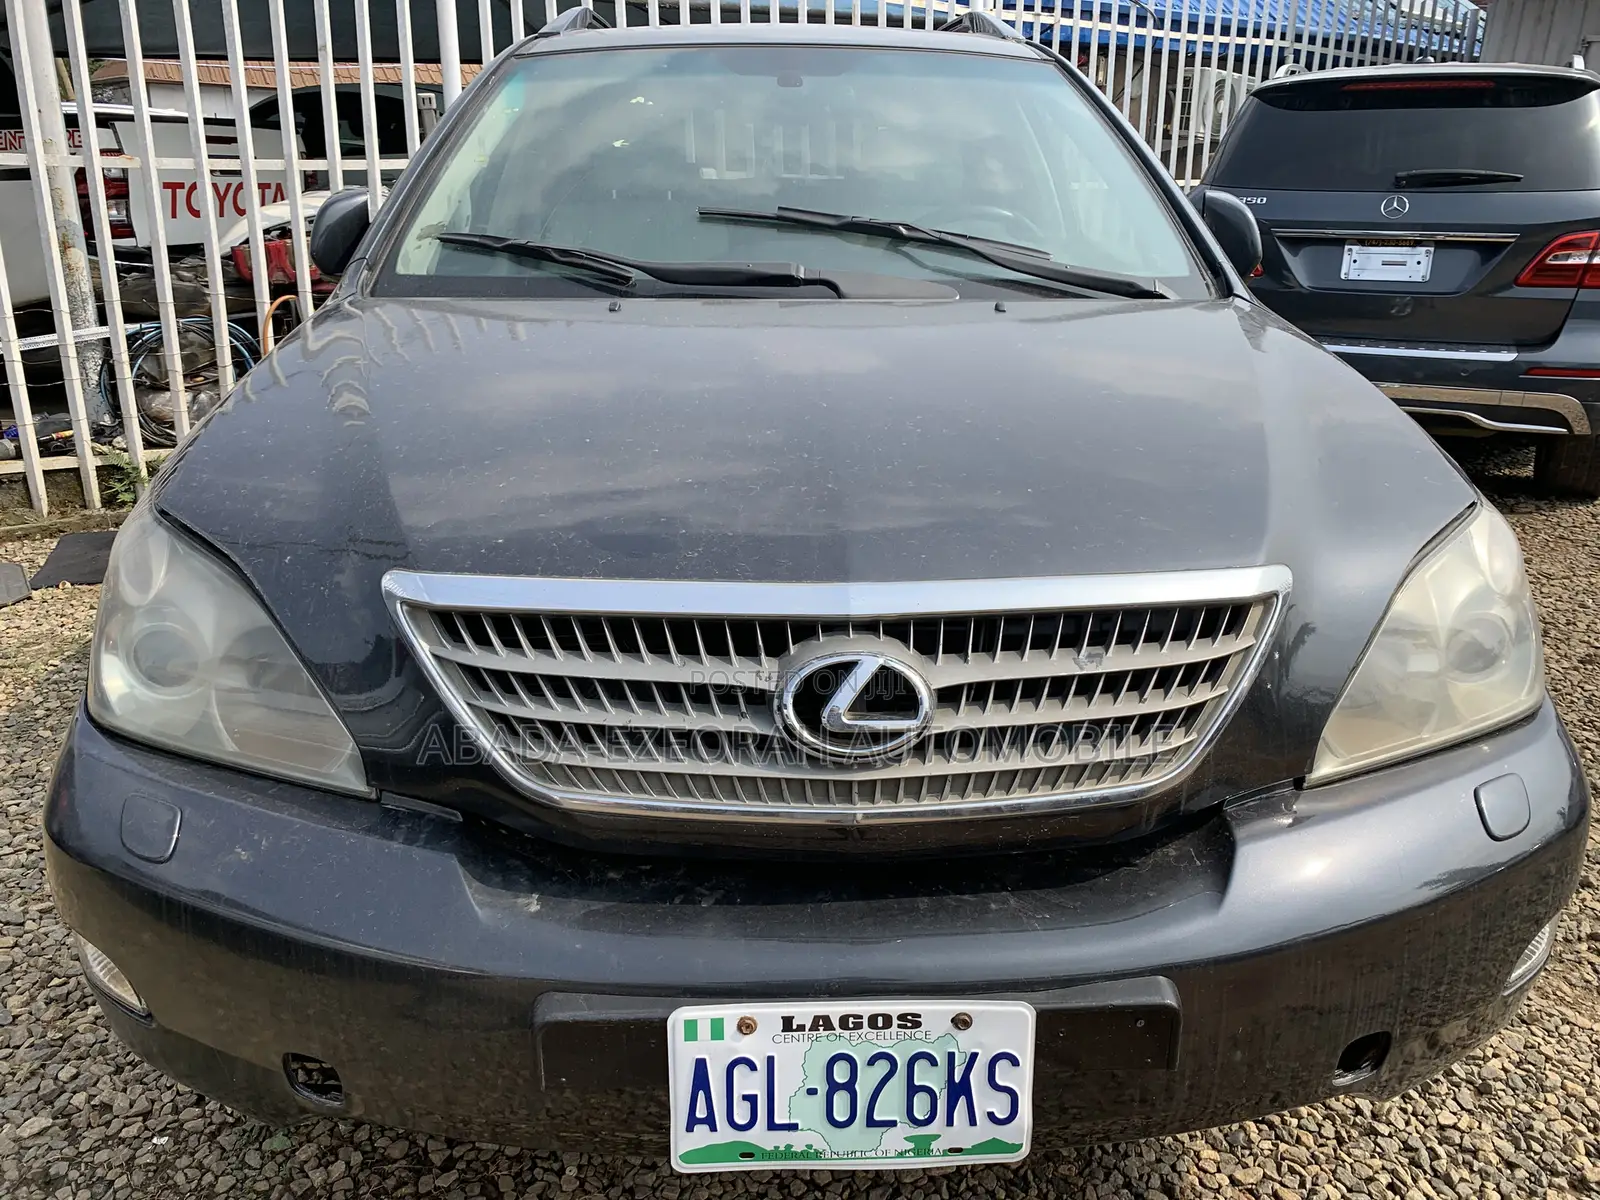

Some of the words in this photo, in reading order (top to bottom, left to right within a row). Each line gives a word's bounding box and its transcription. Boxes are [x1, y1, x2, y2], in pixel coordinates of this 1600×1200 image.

[781, 1012, 923, 1033] LAGOS
[771, 1032, 824, 1045] CENTRE
[826, 1032, 845, 1042] OF
[850, 1030, 932, 1041] EXCELLENCE
[685, 1051, 1021, 1133] AGL-826KS
[761, 1150, 813, 1160] FEDERAL
[815, 1148, 872, 1159] REPUBLIC
[874, 1148, 890, 1158] OF
[894, 1147, 945, 1158] NIGERIA
